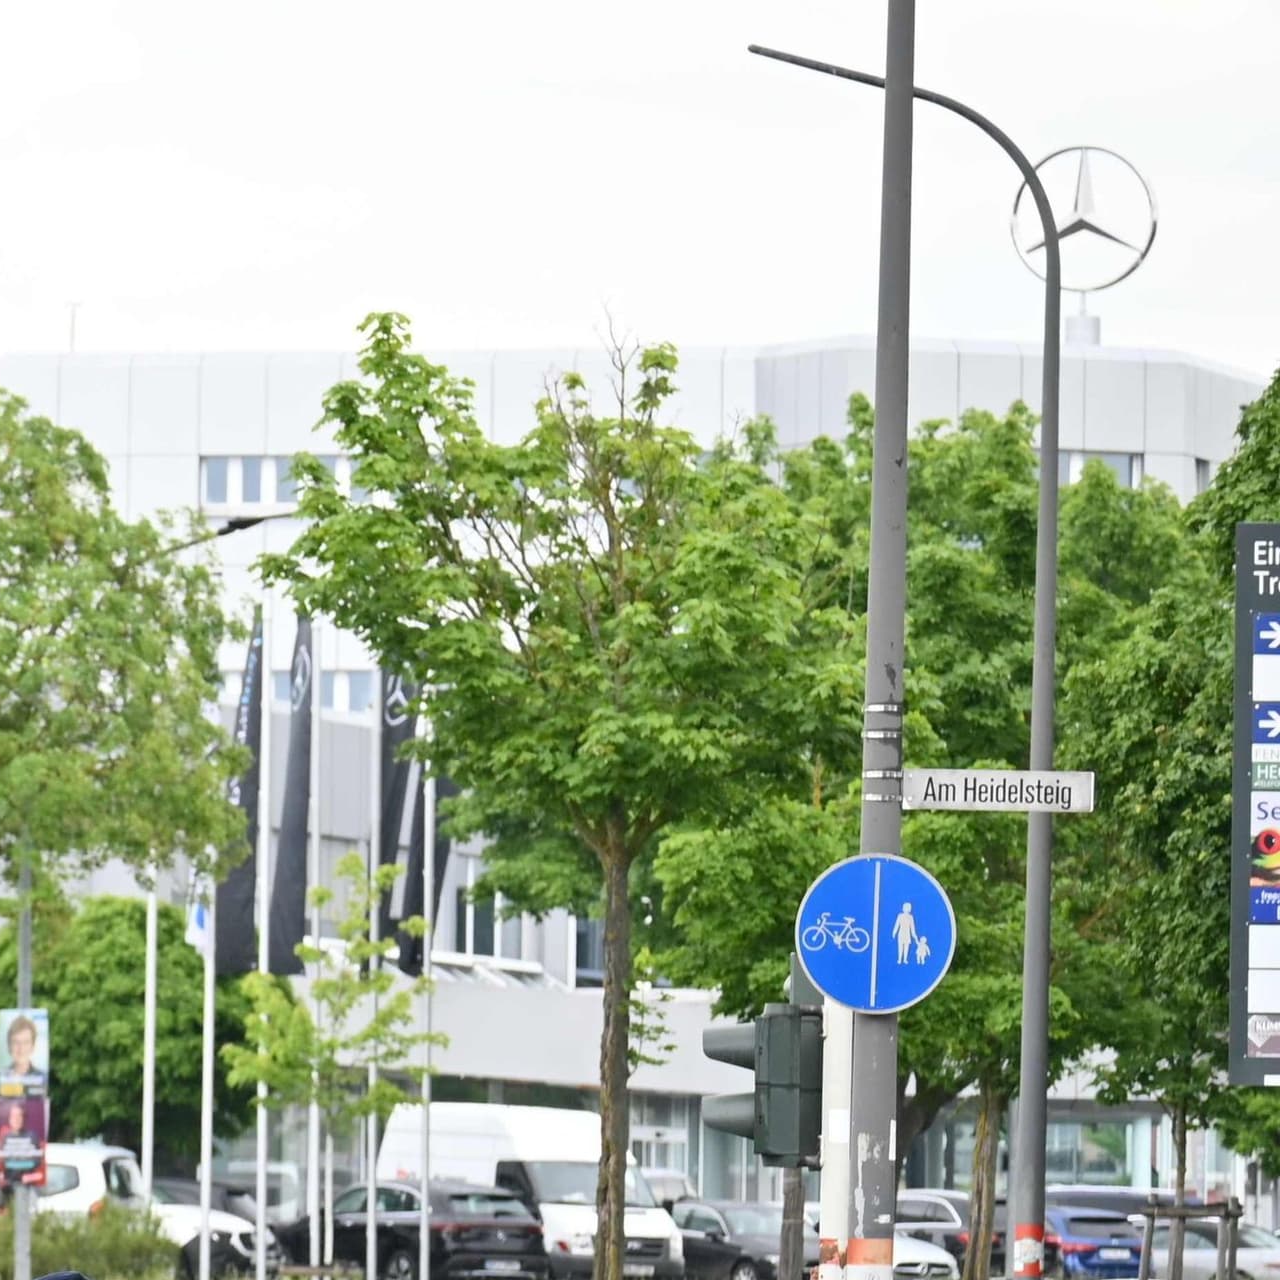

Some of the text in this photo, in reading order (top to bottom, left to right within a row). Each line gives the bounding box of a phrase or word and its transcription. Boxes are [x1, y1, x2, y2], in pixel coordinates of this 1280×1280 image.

[1253, 570, 1280, 595] Tr
[1257, 765, 1280, 780] HE
[923, 776, 1073, 810] Am Heidelsteig
